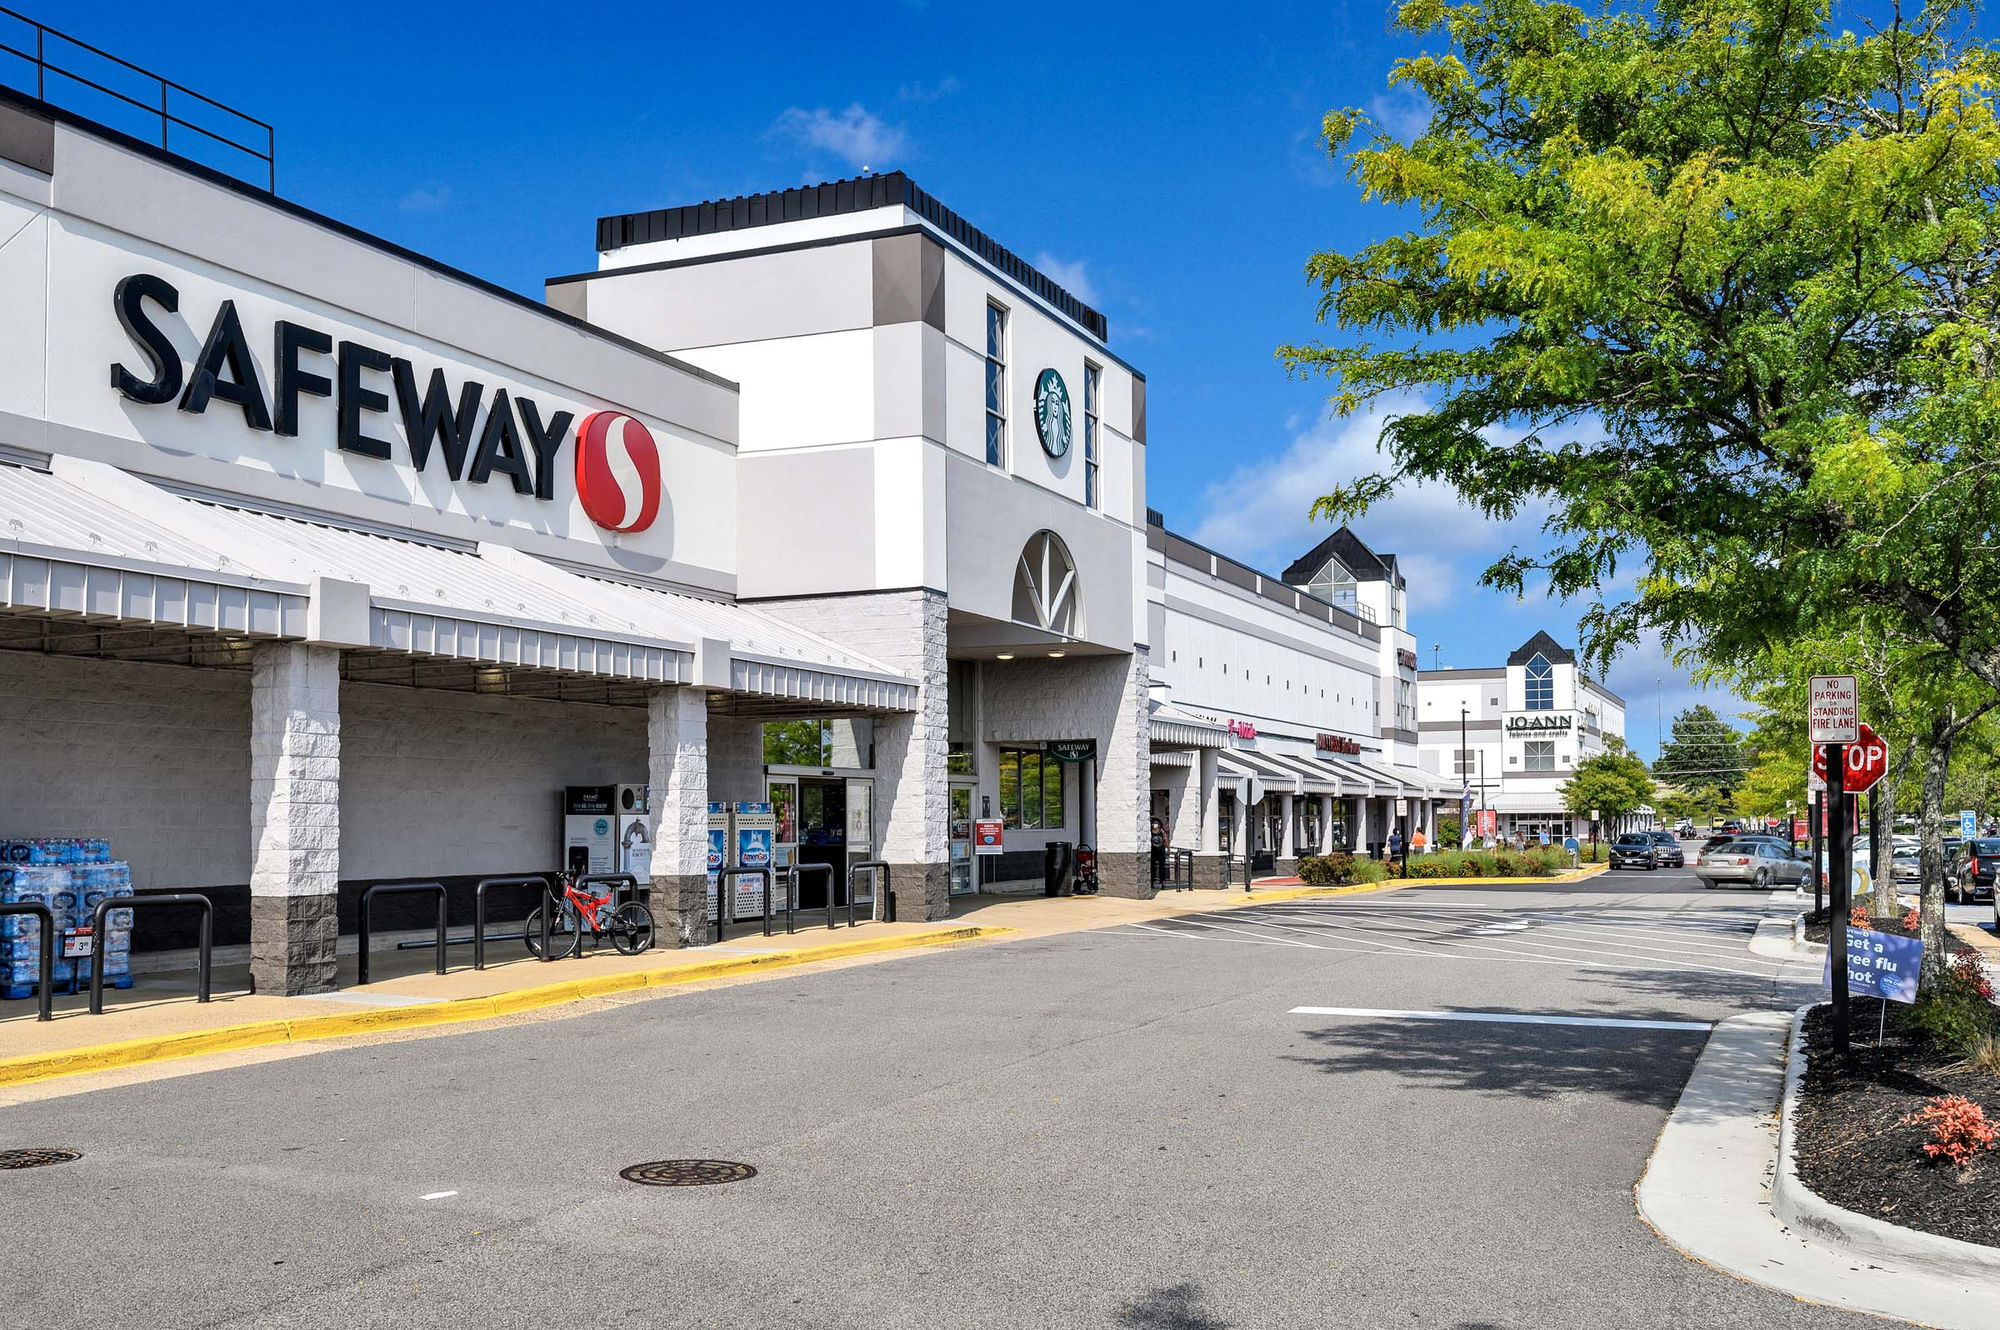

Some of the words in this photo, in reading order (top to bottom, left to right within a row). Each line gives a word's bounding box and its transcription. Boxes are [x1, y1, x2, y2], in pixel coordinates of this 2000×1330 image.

[110, 273, 575, 502] SAFEWAY
[1826, 680, 1839, 689] NO
[1814, 691, 1852, 700] PARKING
[1813, 707, 1854, 717] STANDING
[1813, 718, 1831, 729] FIRE
[1833, 718, 1855, 729] LANE
[1058, 743, 1090, 751] SAFEWAY
[1817, 745, 1883, 772] SOP
[743, 853, 768, 861] AmeriGas
[1874, 943, 1884, 953] a
[1847, 953, 1870, 966] ree
[1875, 957, 1896, 971] flu
[1848, 967, 1876, 984] hot.
